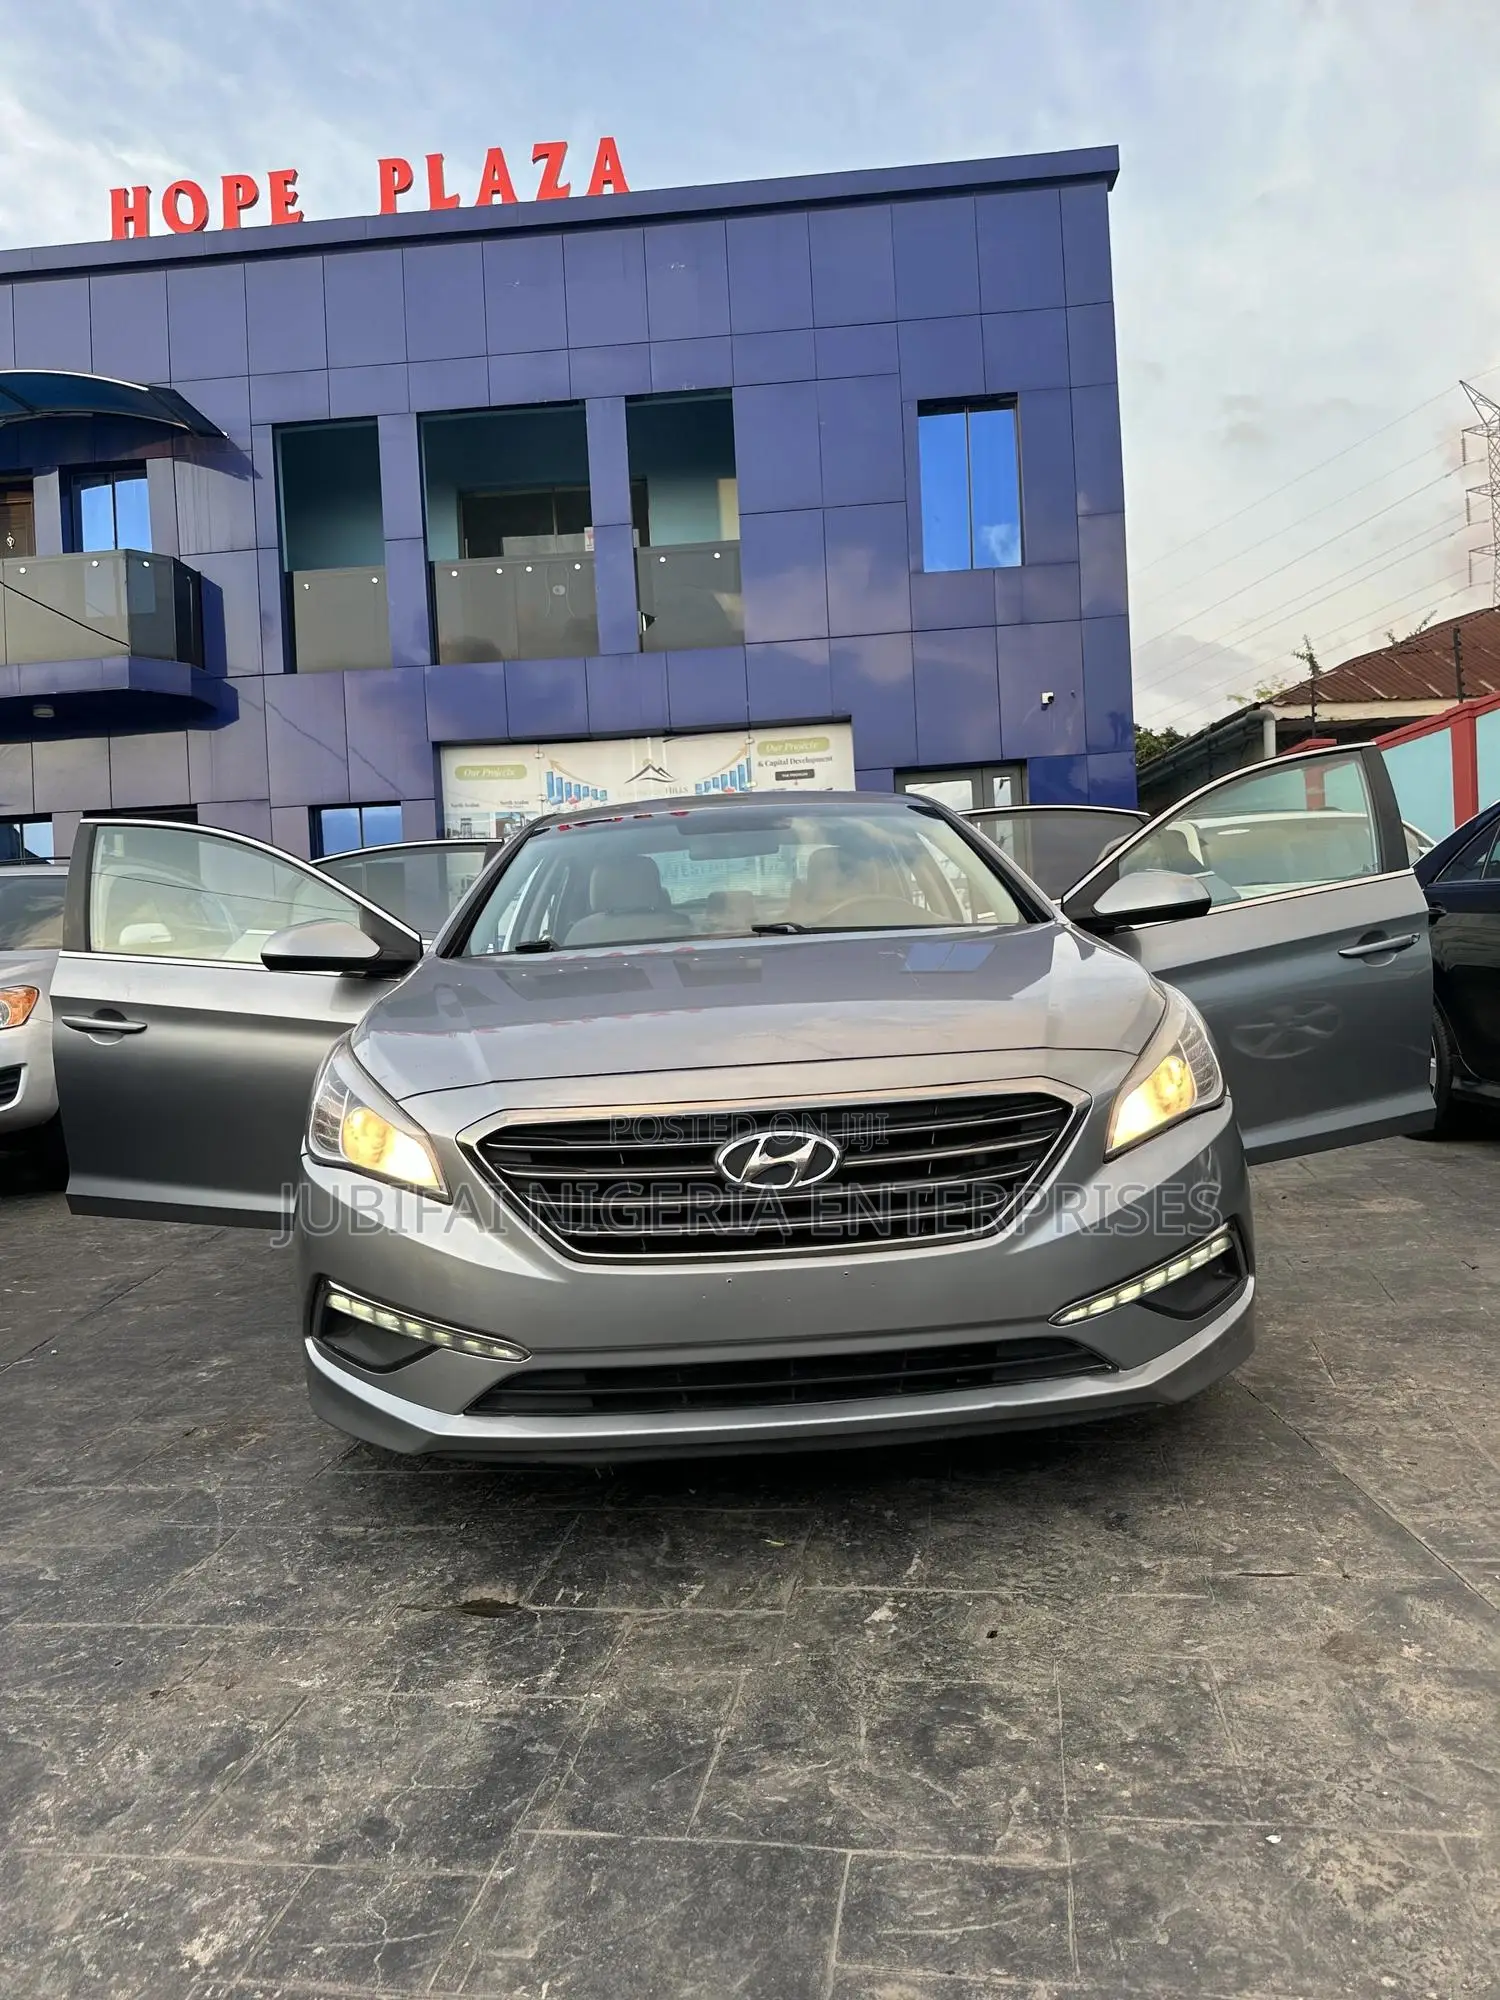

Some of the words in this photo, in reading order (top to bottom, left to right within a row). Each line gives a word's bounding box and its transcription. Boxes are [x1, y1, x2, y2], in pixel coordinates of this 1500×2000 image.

[109, 168, 305, 240] HOPE
[377, 136, 630, 215] PLAZA
[765, 758, 788, 767] Capital
[790, 756, 833, 765] Development
